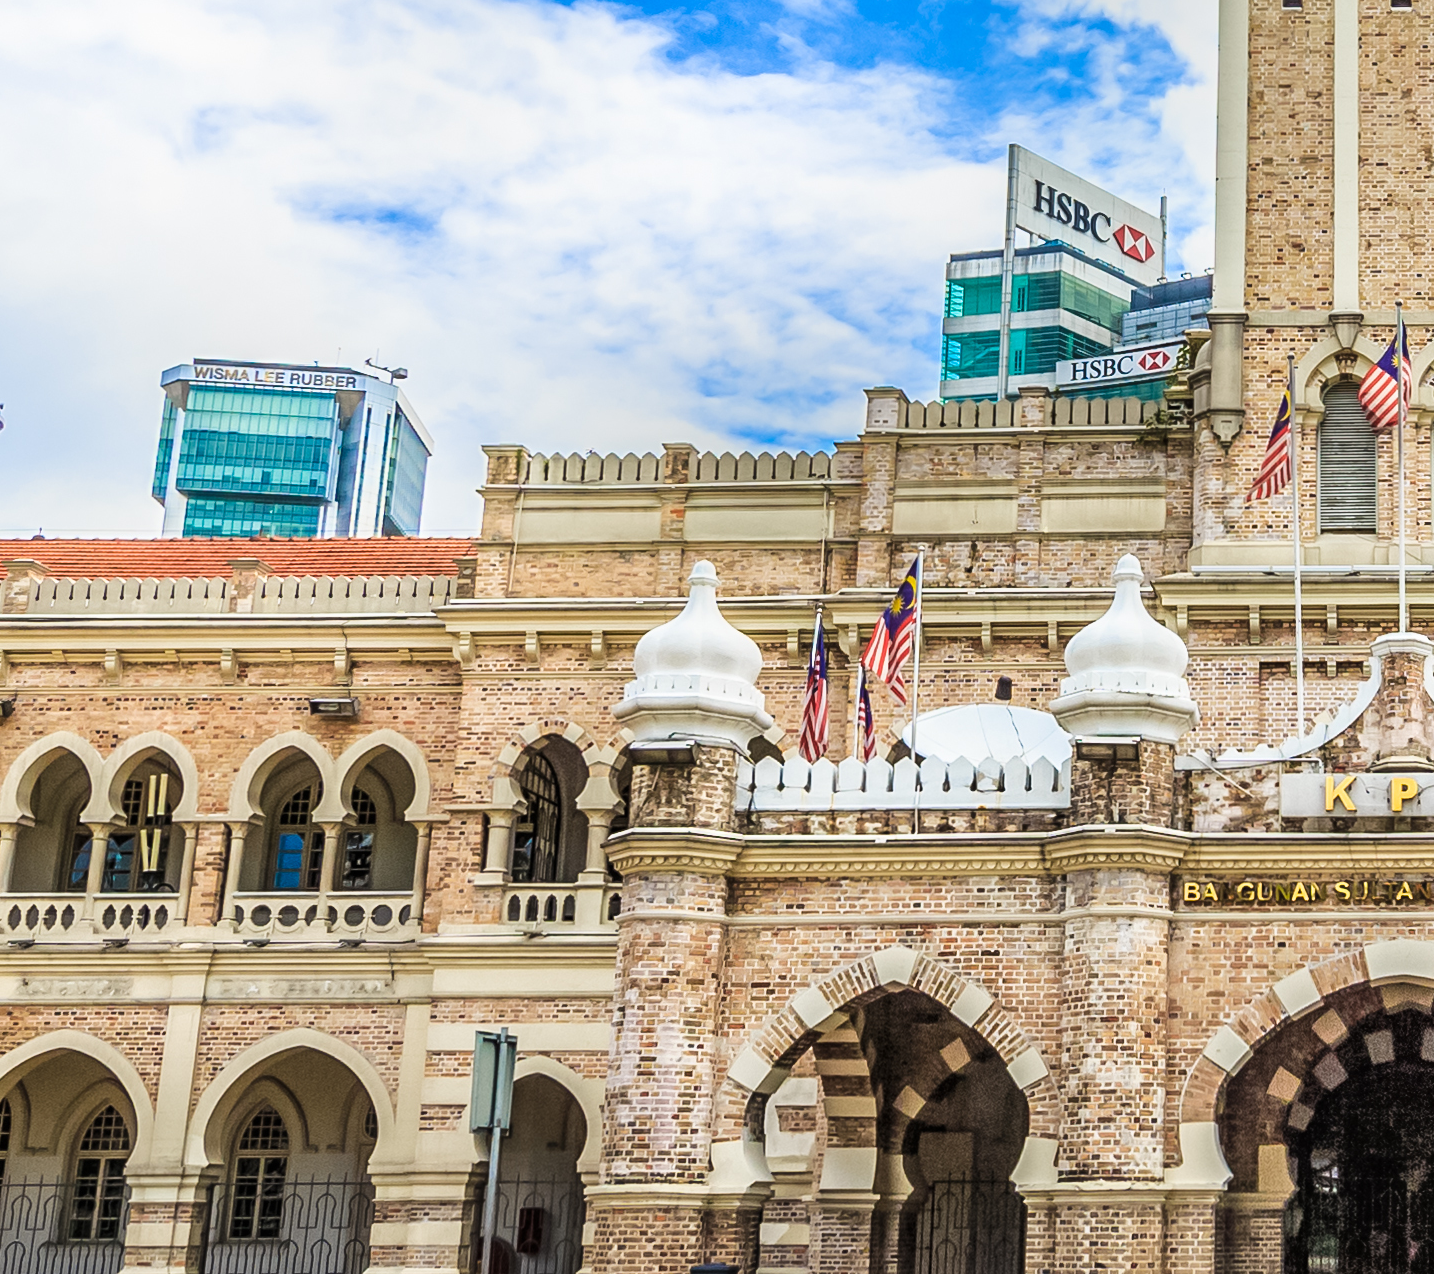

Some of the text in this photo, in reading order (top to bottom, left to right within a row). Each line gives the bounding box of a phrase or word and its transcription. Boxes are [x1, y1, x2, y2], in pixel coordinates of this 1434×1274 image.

[1034, 180, 1111, 243] HSBC
[194, 366, 356, 388] WISMA LEE RUBBER
[1070, 355, 1134, 381] HSBC
[1334, 881, 1432, 902] SULTAN
